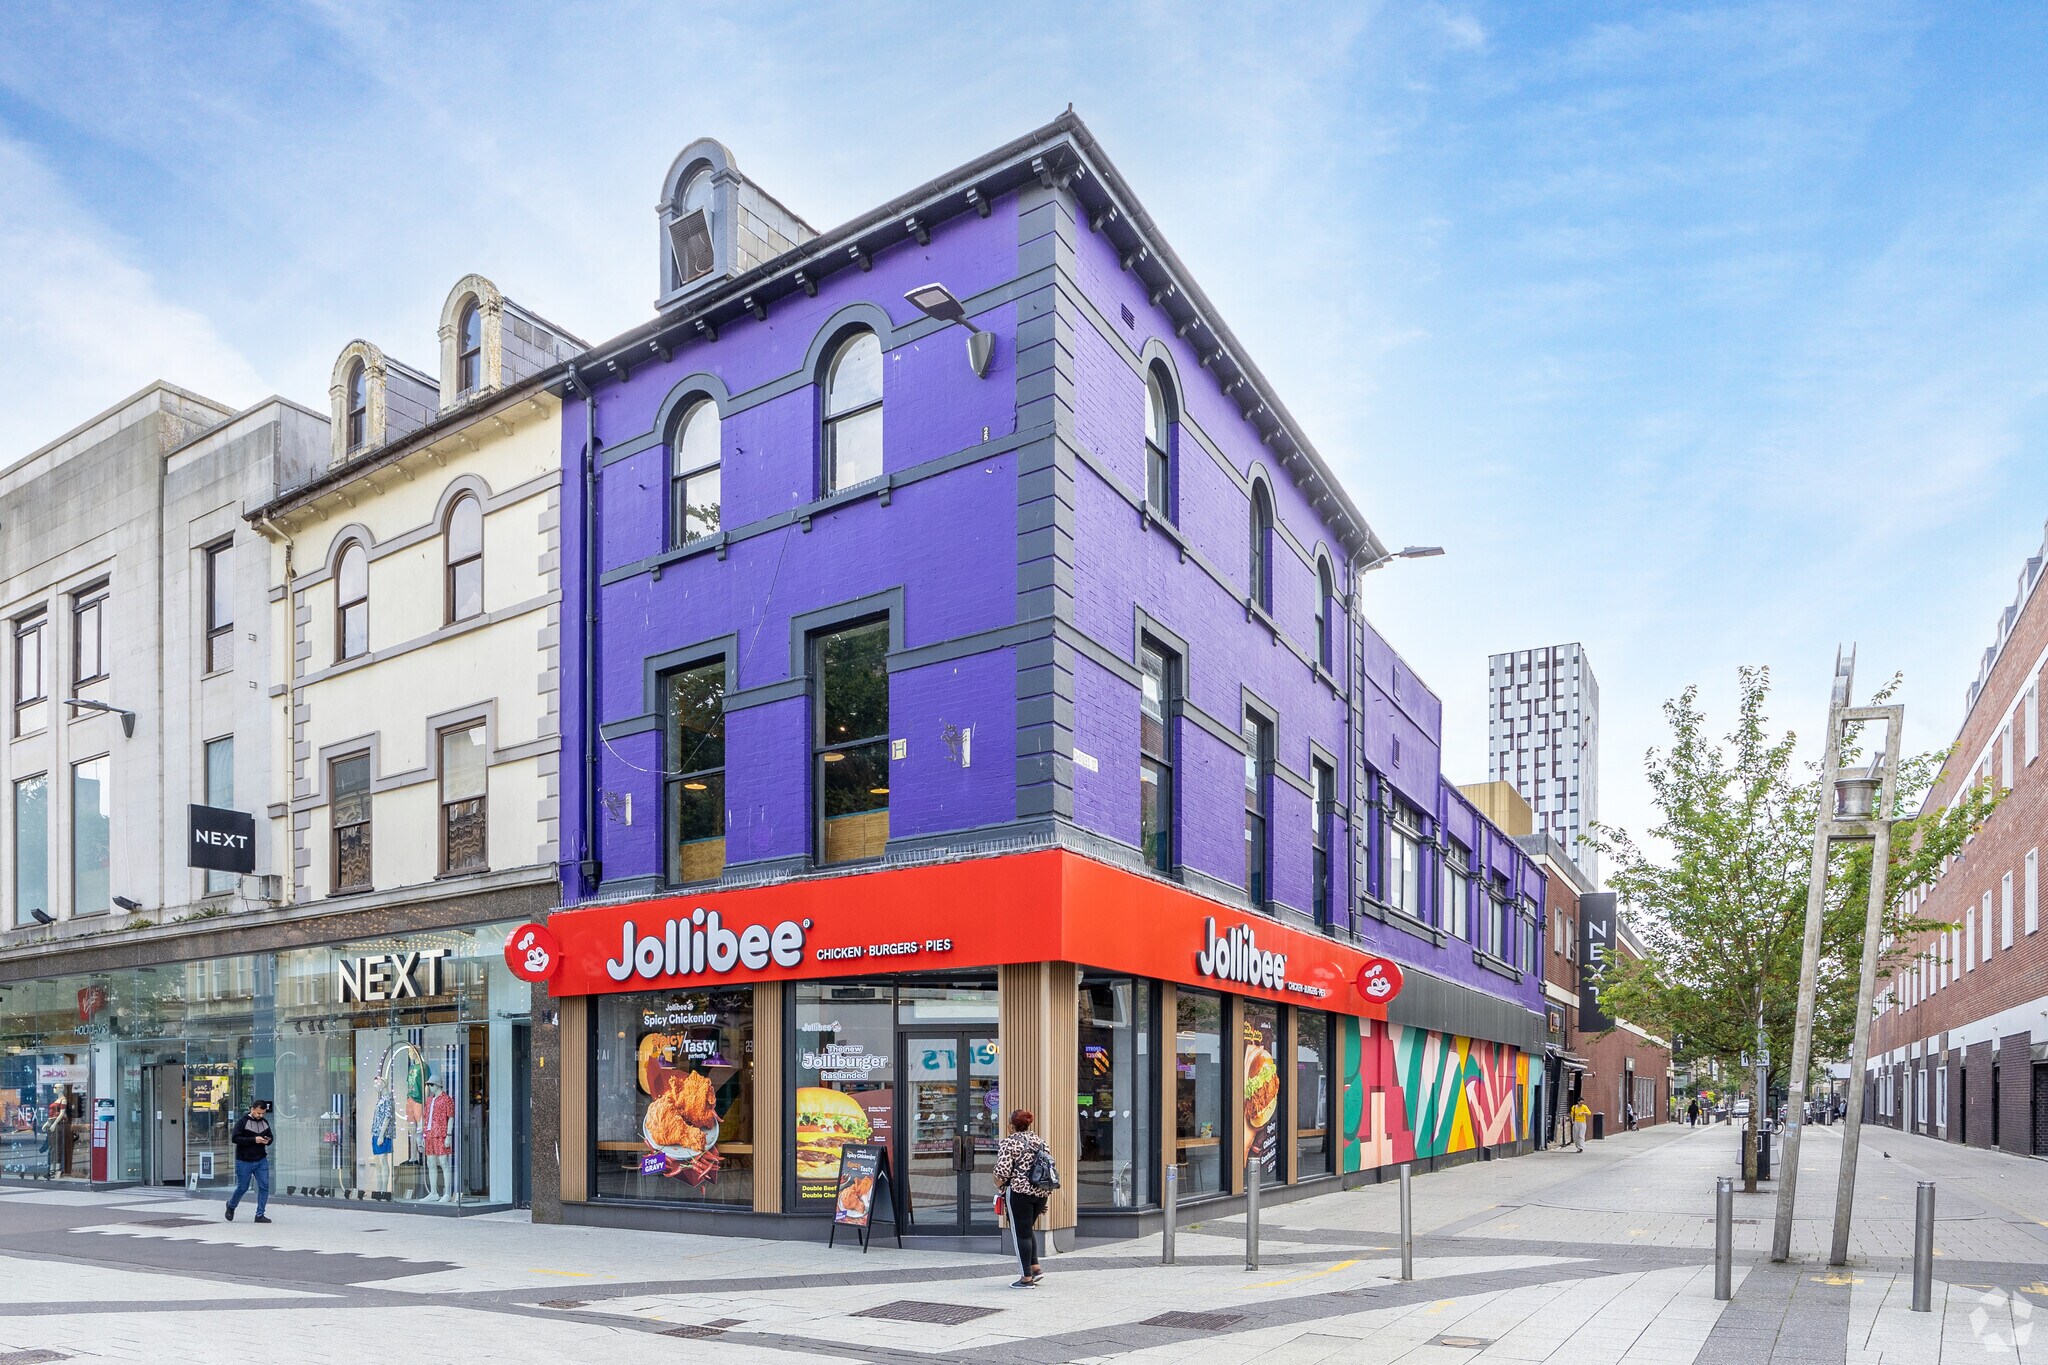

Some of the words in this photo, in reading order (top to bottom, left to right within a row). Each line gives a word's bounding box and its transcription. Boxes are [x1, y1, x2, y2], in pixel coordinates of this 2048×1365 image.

[195, 829, 248, 849] NEXT
[606, 907, 806, 981] Jollibee
[816, 946, 862, 960] CHICKEN
[868, 942, 919, 956] BURGERS
[925, 939, 952, 951] PIES
[1197, 917, 1285, 991] Jollibee
[338, 949, 452, 1003] NEXT
[644, 1015, 669, 1027] Spicy
[669, 1012, 717, 1025] Chickenjoy
[652, 1033, 684, 1047] Spicy
[826, 1044, 843, 1054] The
[843, 1045, 864, 1053] new
[802, 1053, 889, 1071] Jolliburger
[821, 1071, 839, 1080] has
[839, 1071, 868, 1080] landed
[18, 1107, 45, 1121] NEXT
[645, 1162, 664, 1172] GRAVY
